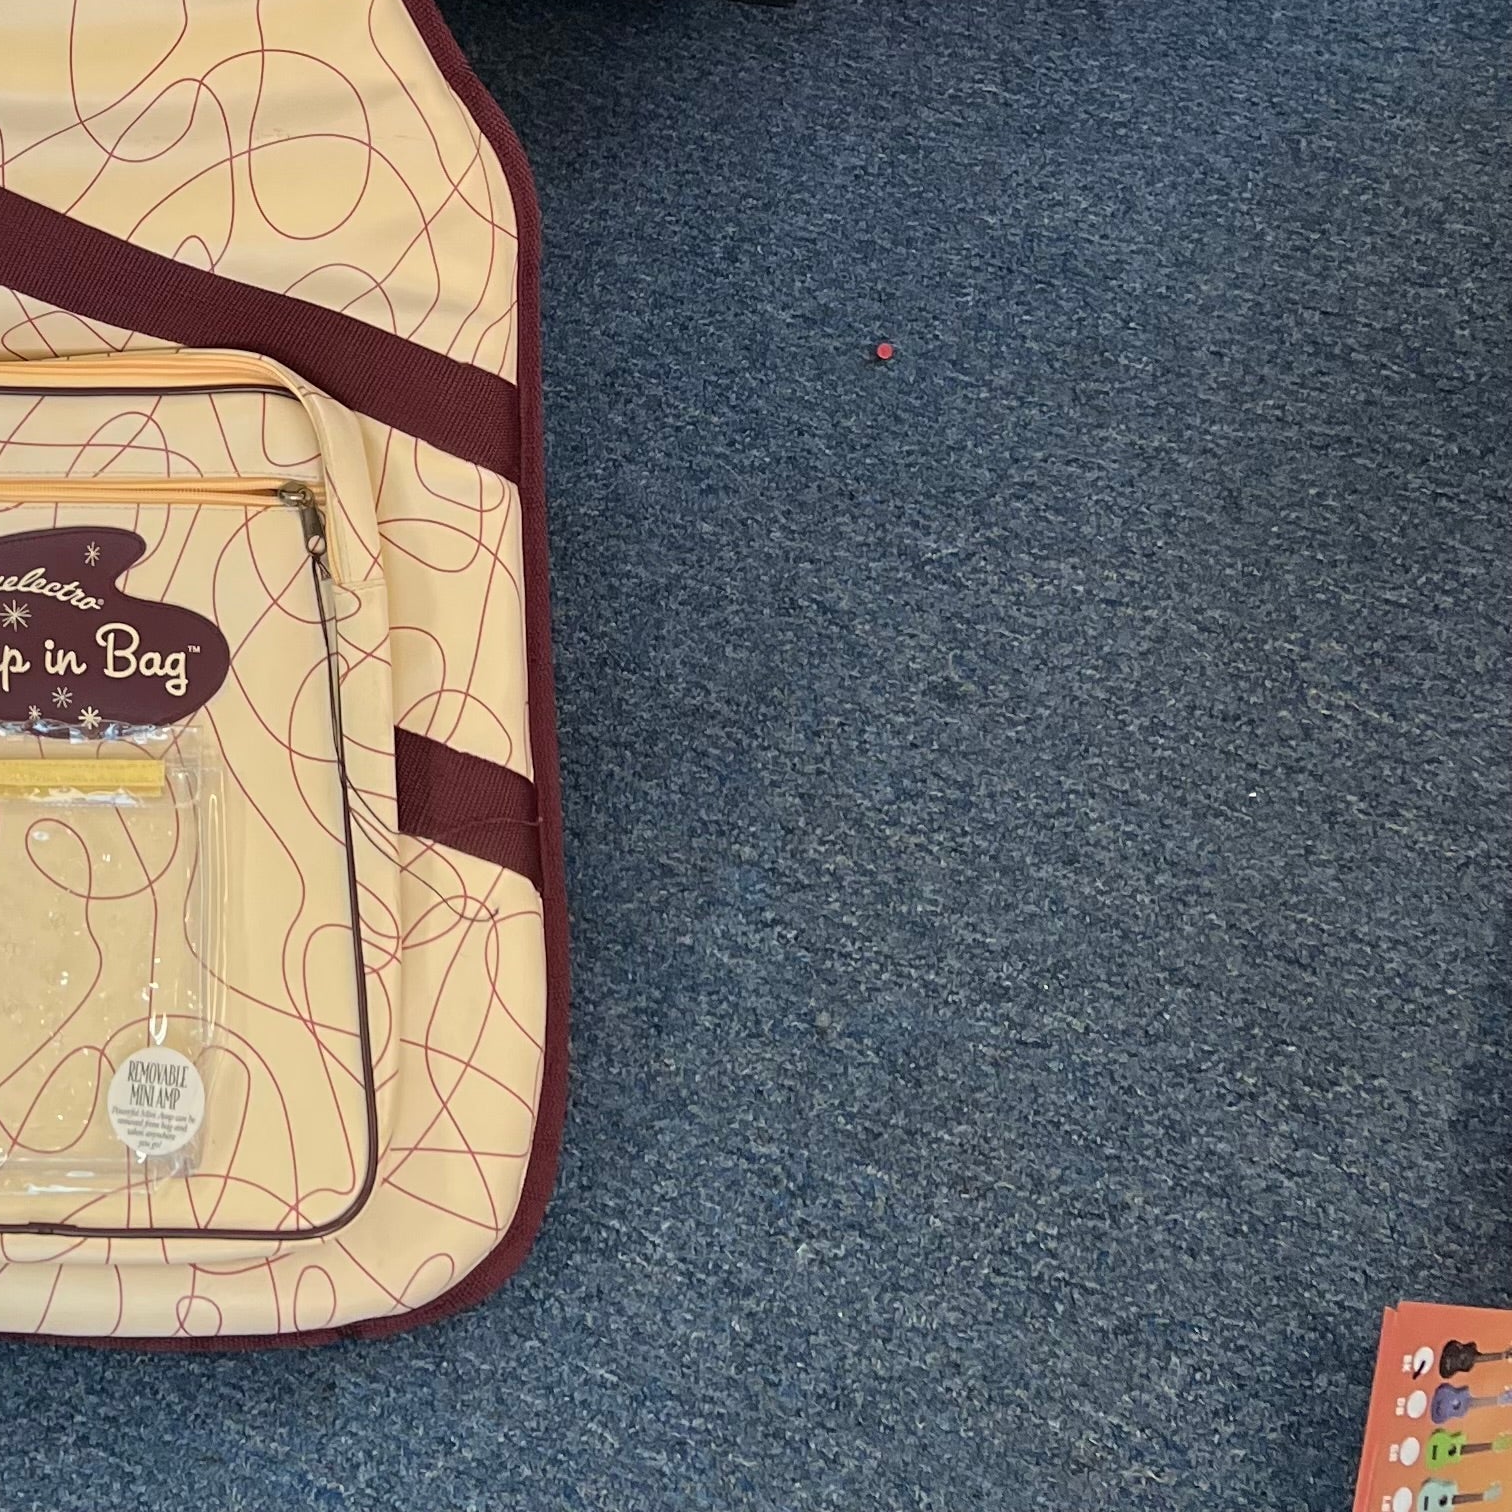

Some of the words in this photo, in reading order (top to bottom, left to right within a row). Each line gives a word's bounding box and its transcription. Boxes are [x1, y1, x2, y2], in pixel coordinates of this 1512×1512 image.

[44, 639, 87, 676] in
[128, 1060, 189, 1088] REMOVABLE
[129, 1084, 155, 1107] MINI
[155, 1088, 181, 1110] AMP
